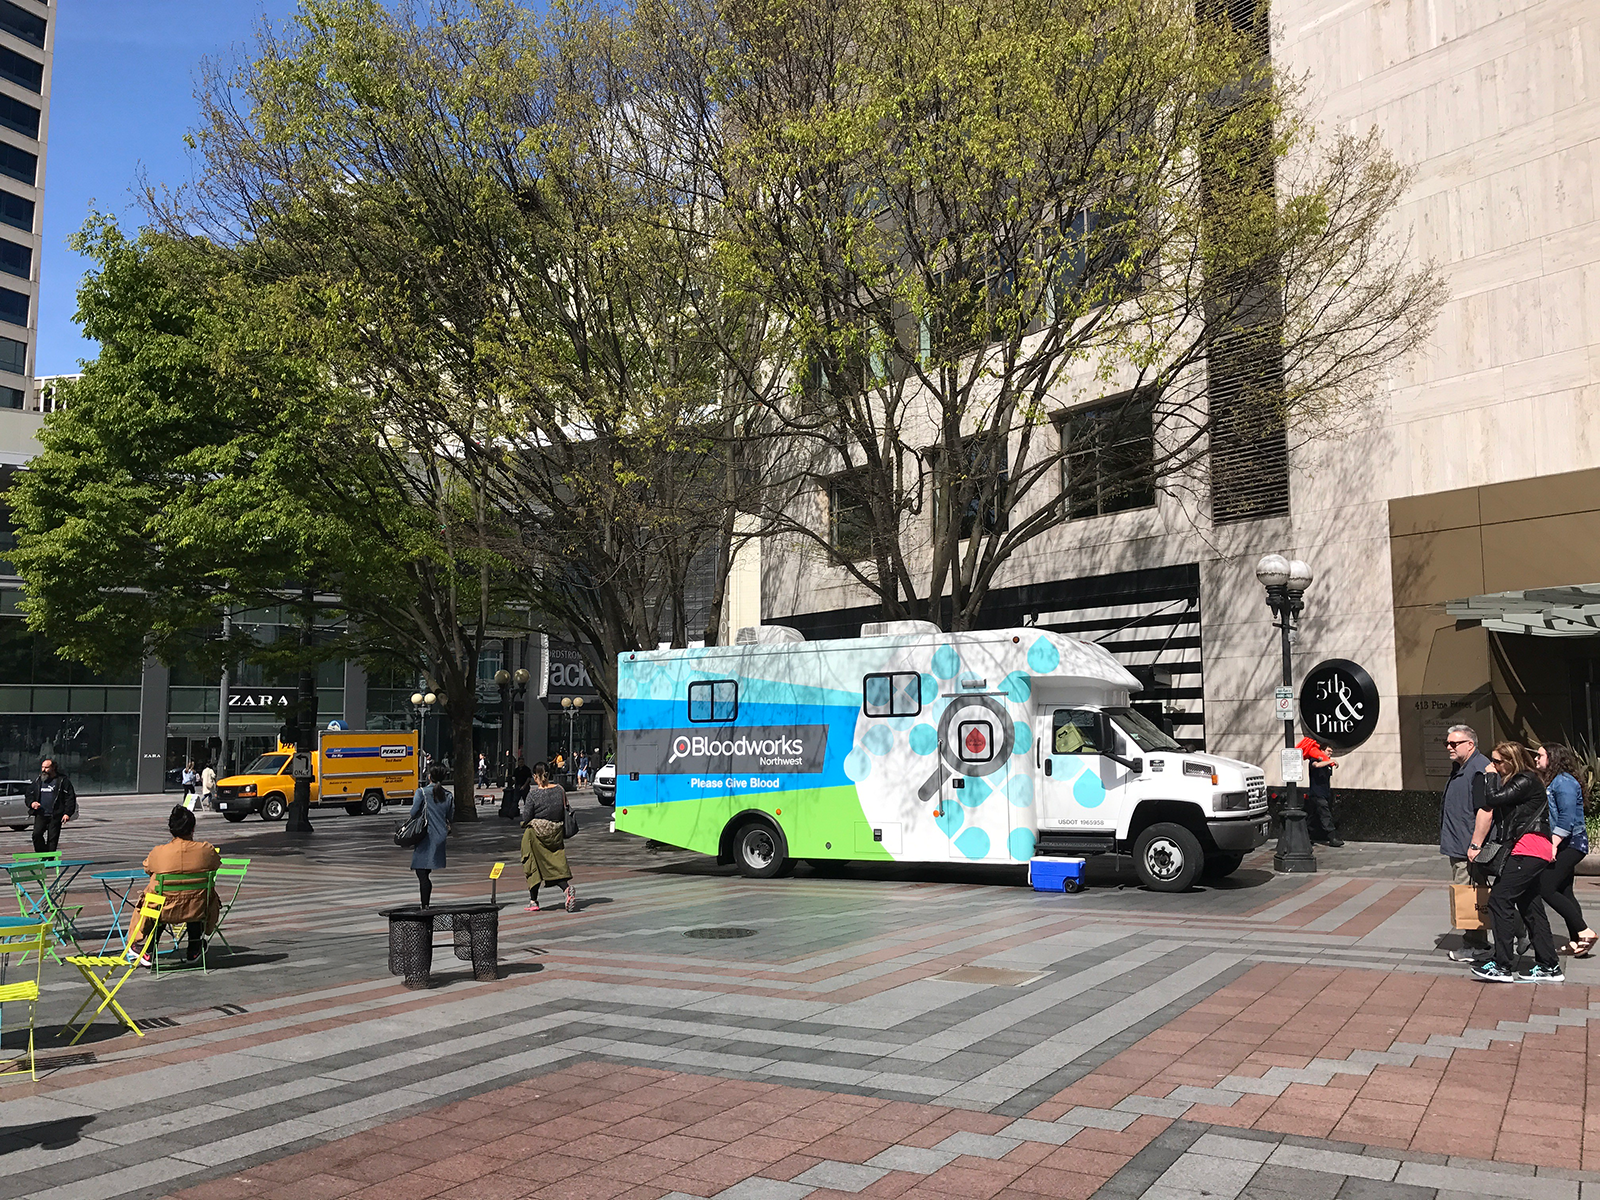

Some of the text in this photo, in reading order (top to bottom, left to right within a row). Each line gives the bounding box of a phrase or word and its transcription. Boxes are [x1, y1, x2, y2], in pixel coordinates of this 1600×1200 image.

[549, 661, 593, 687] ack
[1316, 673, 1345, 700] 5th
[228, 695, 288, 706] ZARA
[1335, 686, 1364, 720] &
[1431, 700, 1448, 710] Pine
[1315, 713, 1354, 733] Pine
[692, 735, 803, 756] Bloodworks
[760, 757, 803, 765] Northwest
[690, 778, 780, 788] Please Give Blood
